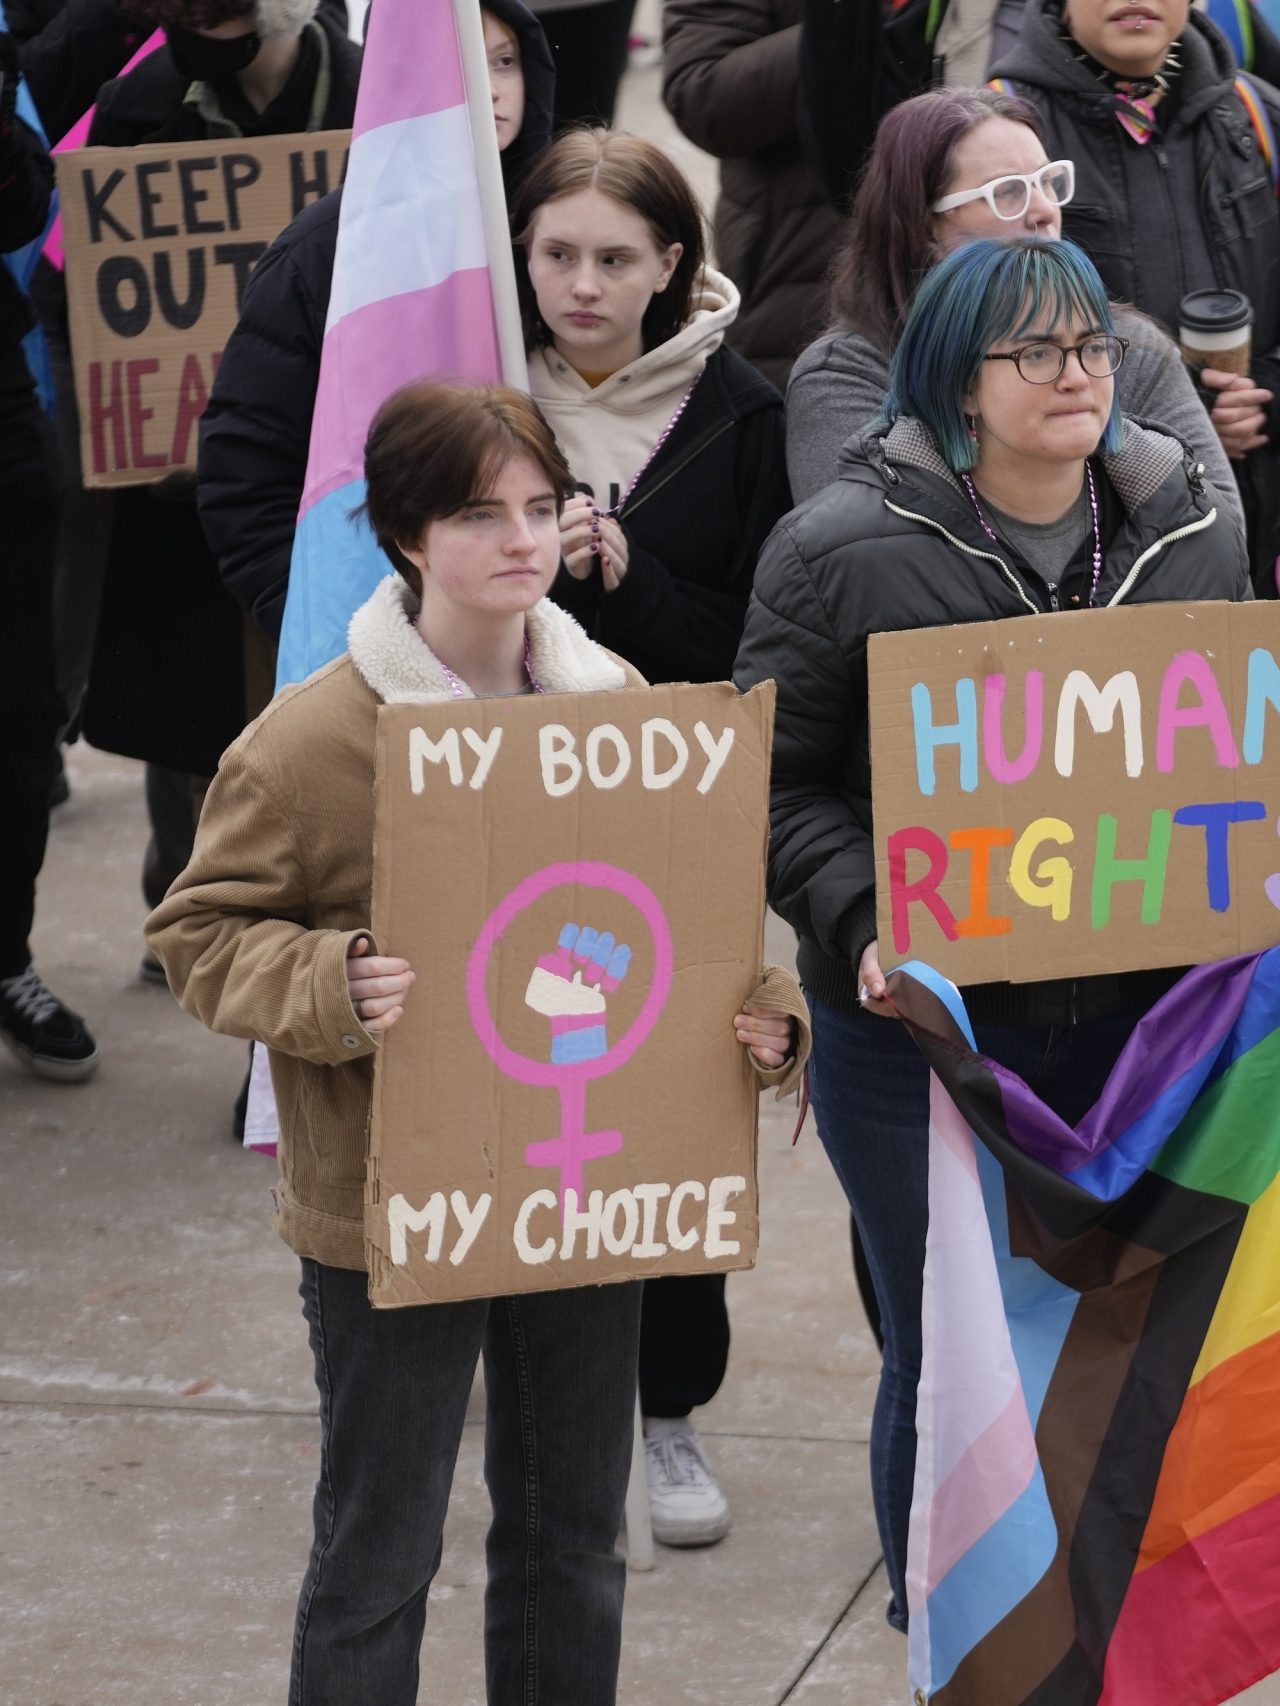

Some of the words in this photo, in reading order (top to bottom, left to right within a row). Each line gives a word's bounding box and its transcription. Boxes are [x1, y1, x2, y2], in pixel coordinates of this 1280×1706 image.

[82, 153, 261, 243] KEEP
[289, 149, 351, 220] H
[96, 240, 268, 338] OUT
[88, 351, 223, 475] HEA
[408, 725, 503, 795] MY
[538, 718, 735, 797] BODY
[387, 1189, 493, 1267] MY
[513, 1175, 747, 1266] CHOICE
